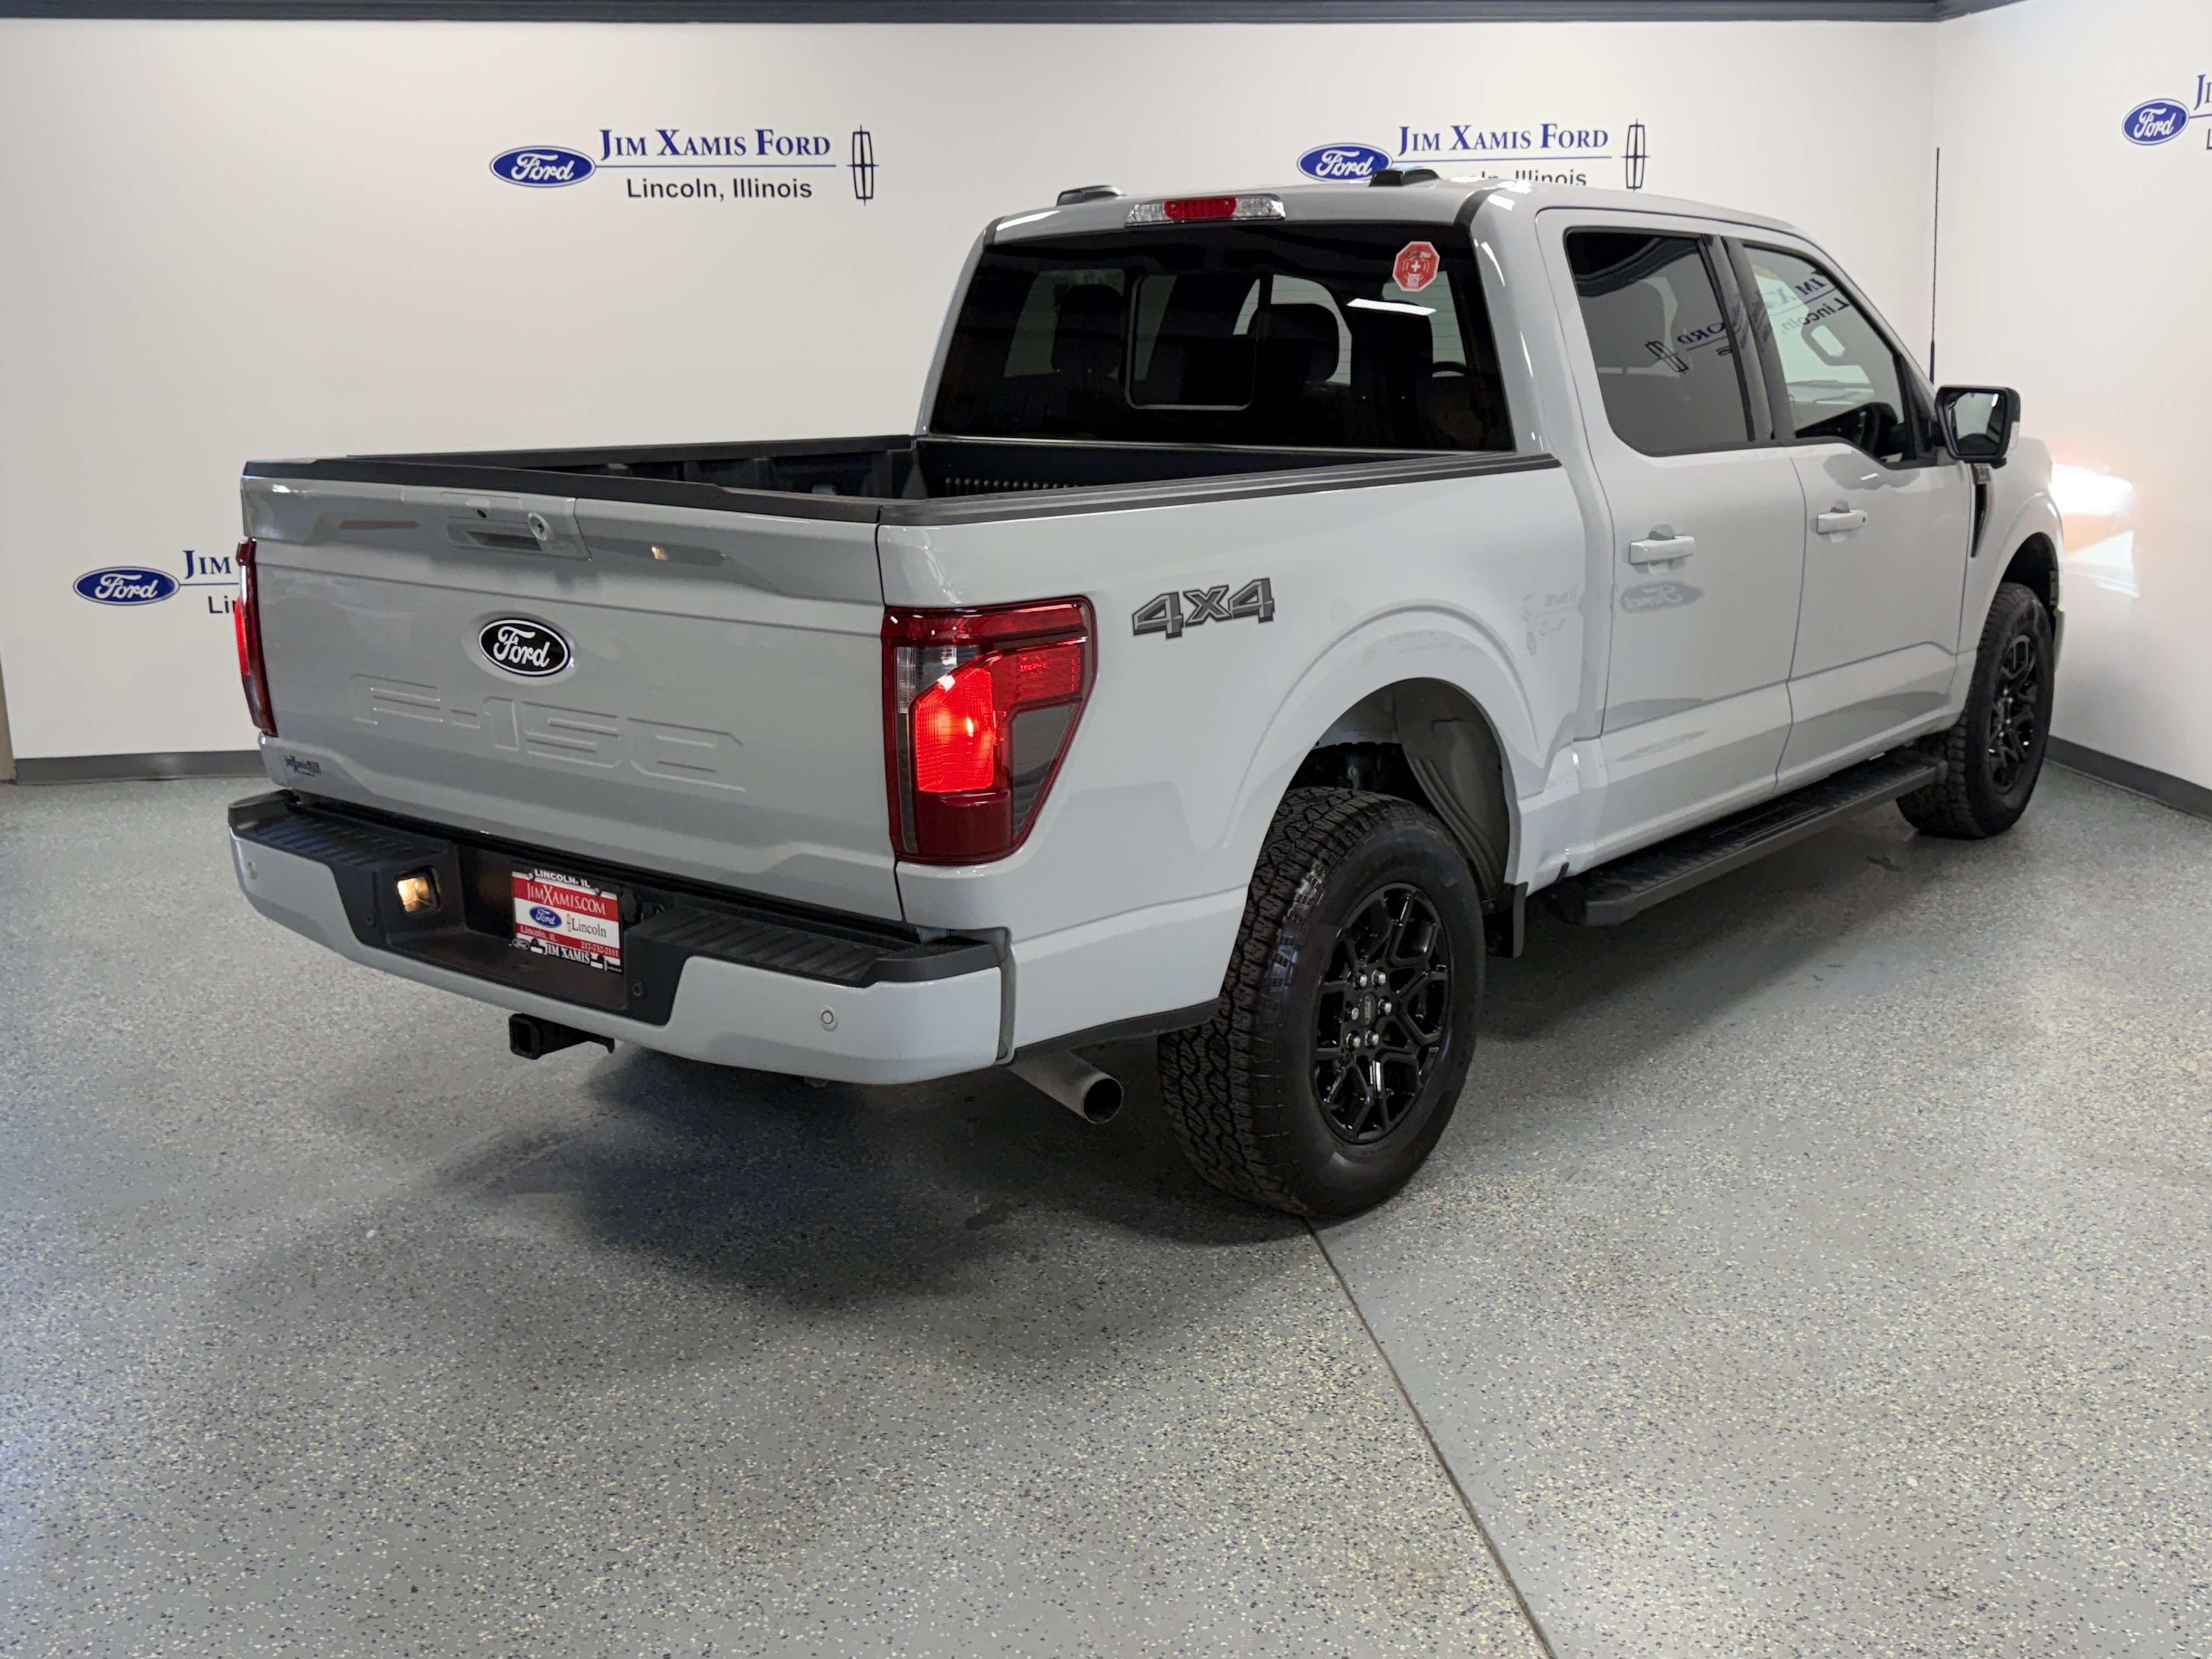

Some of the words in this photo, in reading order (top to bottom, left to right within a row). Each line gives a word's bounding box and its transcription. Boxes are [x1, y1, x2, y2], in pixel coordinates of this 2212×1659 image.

[2193, 74, 2212, 111] JI
[2134, 108, 2176, 138] Ford
[599, 129, 647, 160] JIM
[656, 129, 747, 156] XAMIS
[755, 129, 831, 156] FORD
[1398, 126, 1441, 156] JIM
[1449, 125, 1532, 151] XAMIS
[1540, 123, 1609, 149] FORD
[511, 154, 574, 181] Ford
[1316, 149, 1374, 176] Ford
[627, 178, 724, 202] Lincoln,
[733, 179, 812, 198] Illinois
[182, 550, 232, 580] JIM
[94, 573, 159, 599] Ford
[494, 626, 550, 667] Ford
[349, 673, 747, 792] F-150
[581, 879, 591, 888] IL
[527, 883, 606, 915] JIMXAMIS.COM
[535, 909, 556, 926] Ford
[572, 918, 607, 938] Lincoln
[550, 933, 558, 942] IL
[543, 943, 560, 957] JIM
[561, 947, 590, 964] XAMIS
